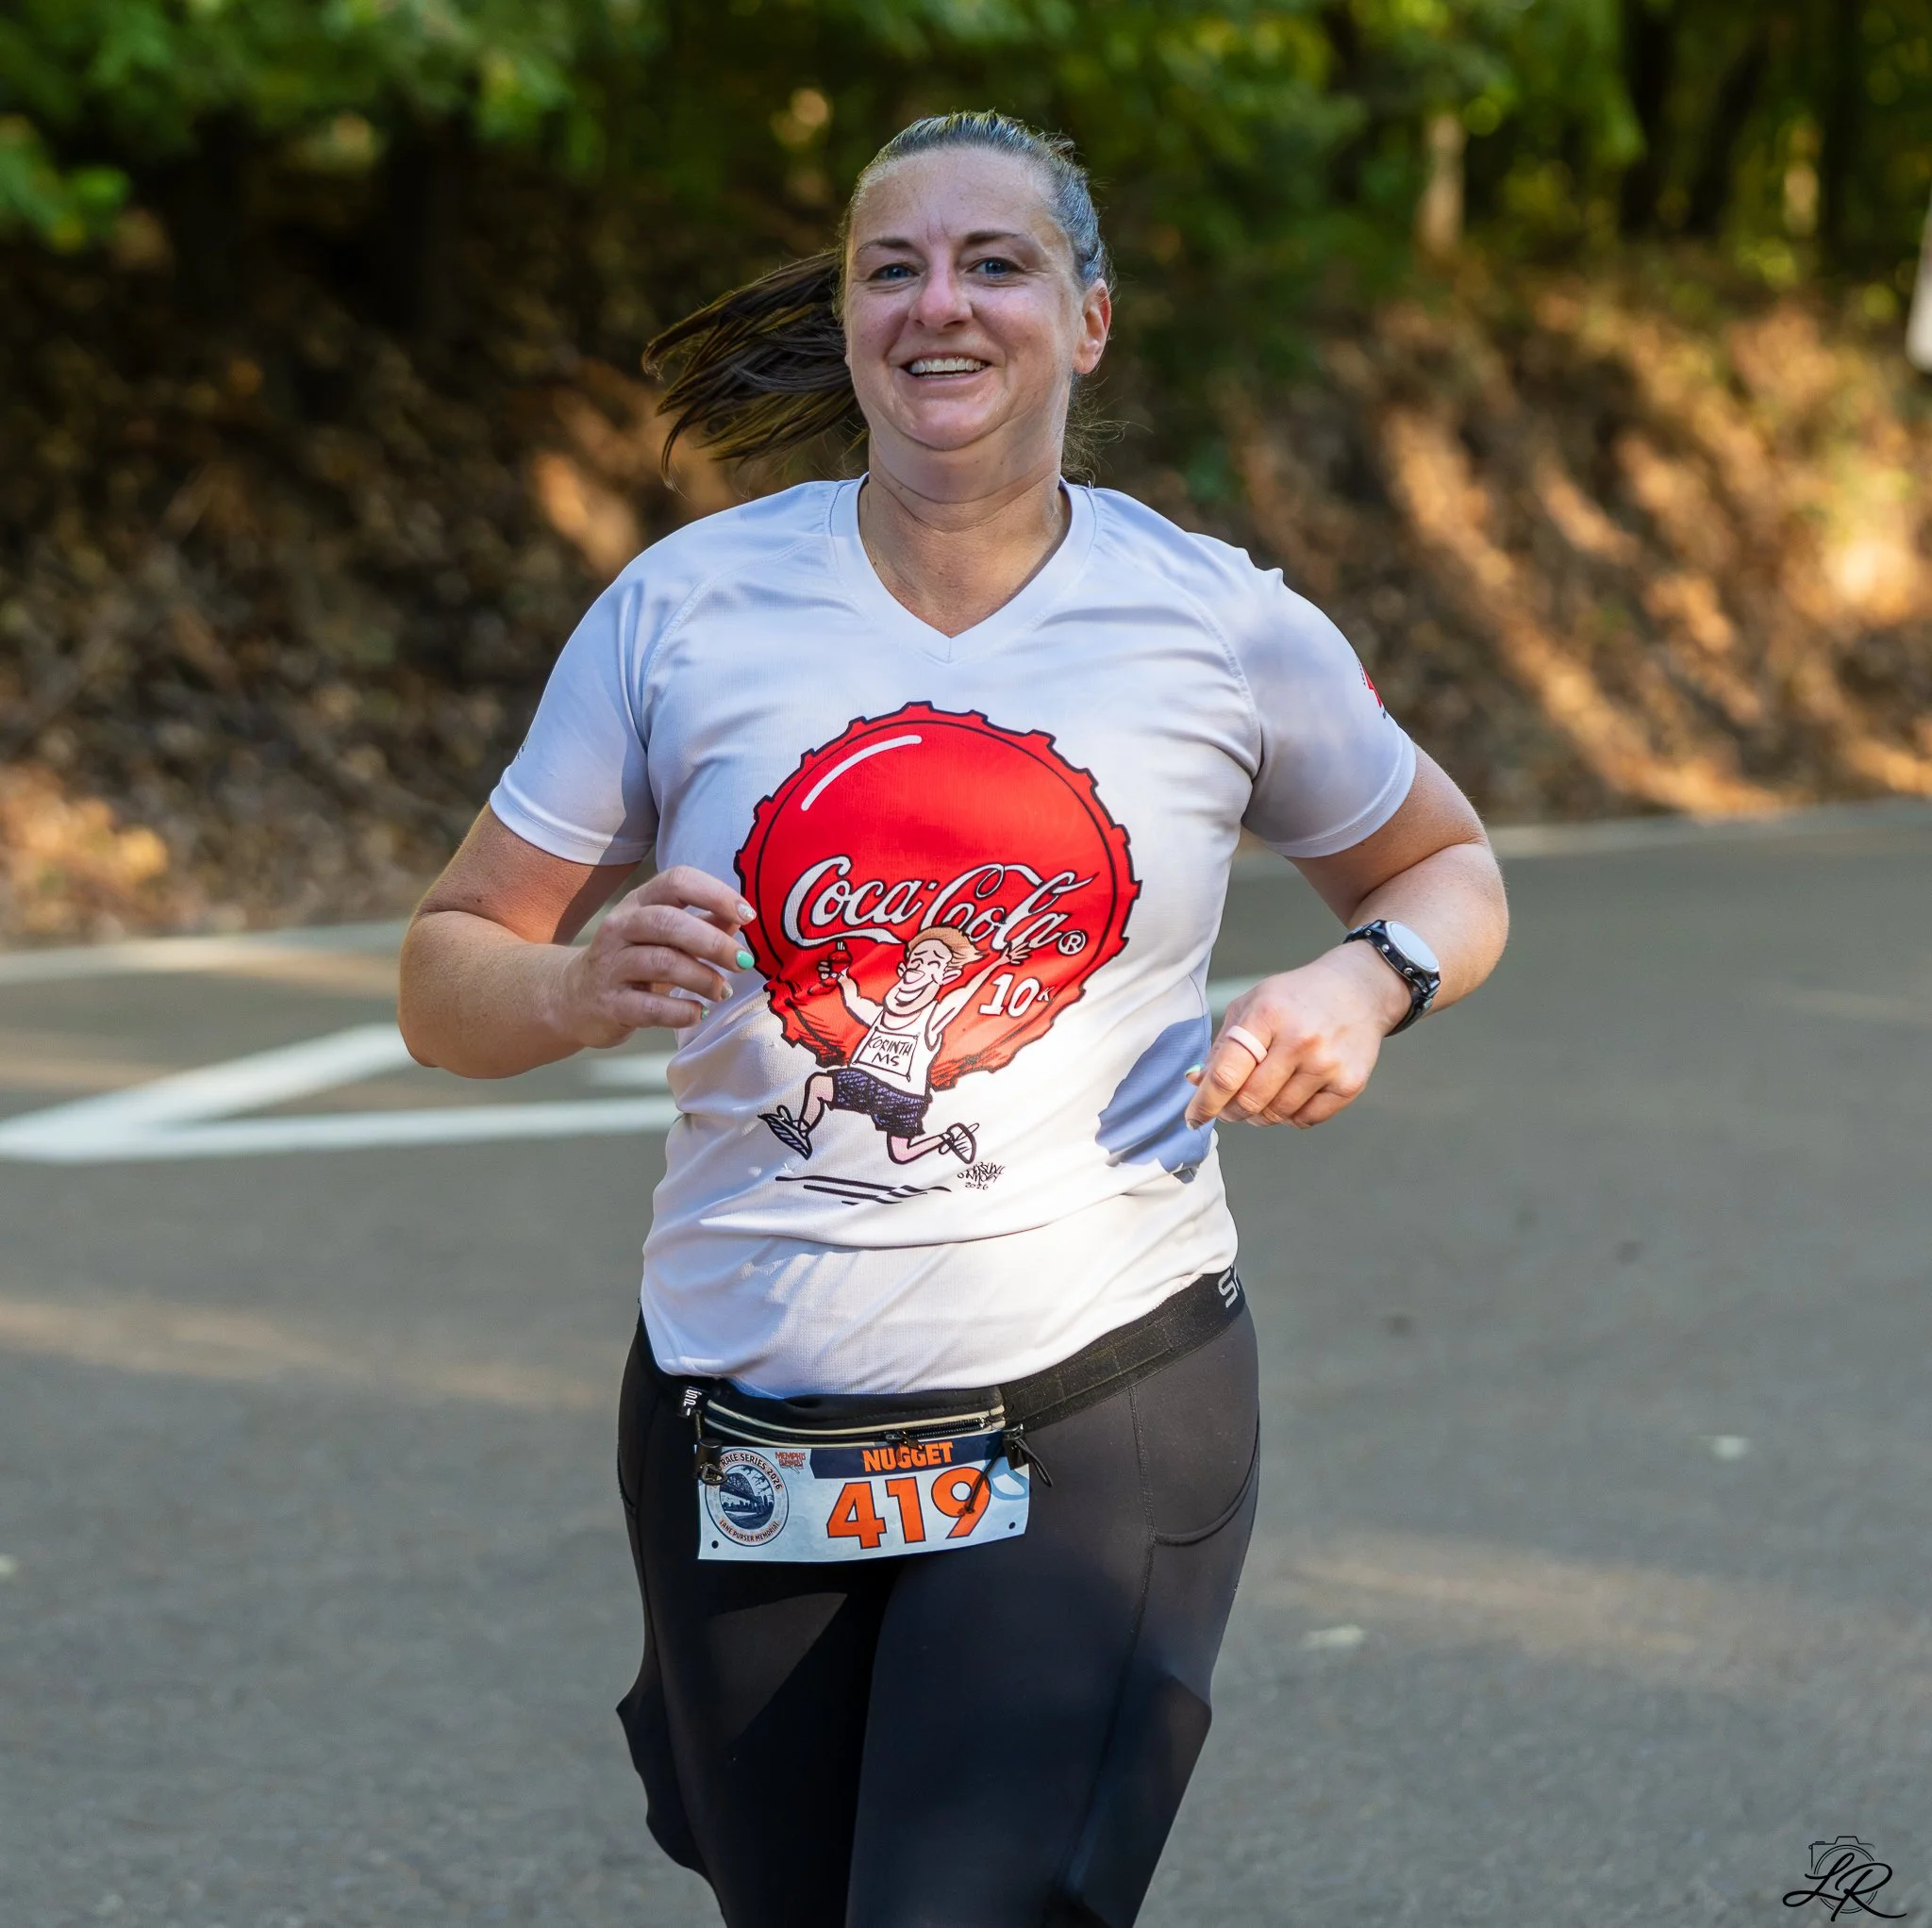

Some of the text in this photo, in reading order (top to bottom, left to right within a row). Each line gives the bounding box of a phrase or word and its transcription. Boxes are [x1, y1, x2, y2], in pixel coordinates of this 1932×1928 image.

[868, 1036, 913, 1056] CORINTH
[872, 1052, 900, 1067] MS
[774, 1451, 807, 1461] MEMPHIS
[861, 1441, 954, 1472] NUGGET
[721, 1454, 739, 1468] RACE
[741, 1453, 767, 1471] SERIES
[766, 1469, 784, 1490] 2026
[825, 1466, 991, 1550] 419
[720, 1520, 780, 1542] LANE PURSER MEMORIAL
